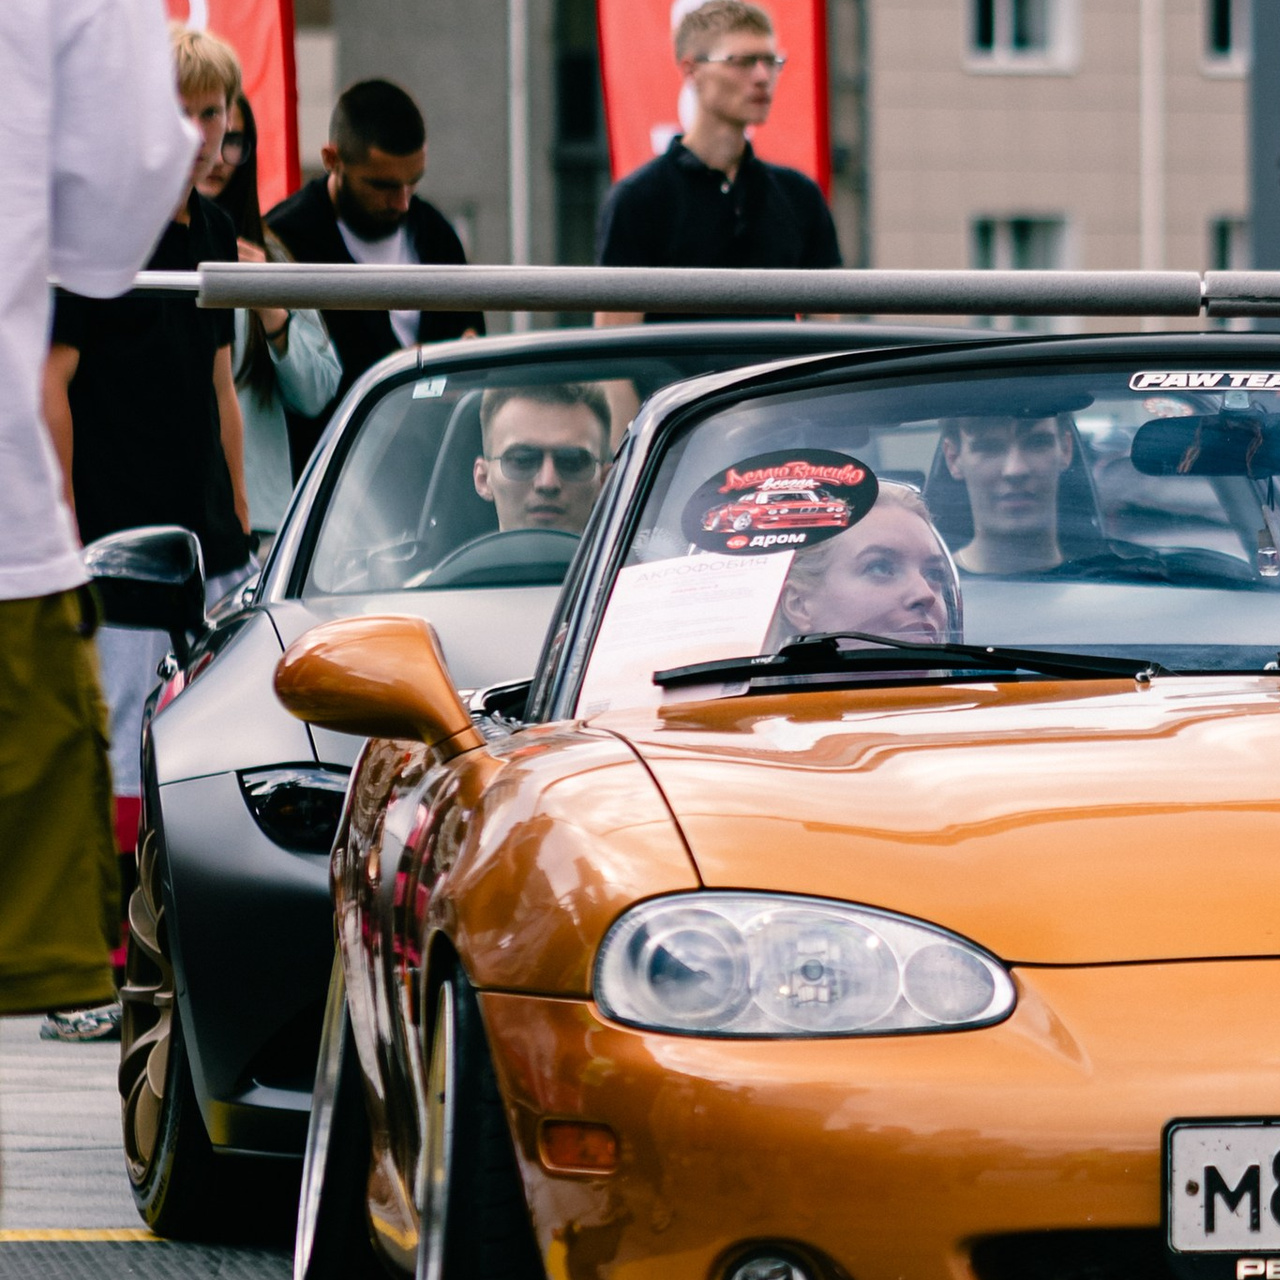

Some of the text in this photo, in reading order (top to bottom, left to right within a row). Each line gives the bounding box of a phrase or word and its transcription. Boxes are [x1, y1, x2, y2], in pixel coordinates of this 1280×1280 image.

[1137, 373, 1222, 388] PAW
[750, 533, 807, 548] дром
[636, 556, 769, 583] АКРОФОБИЯ
